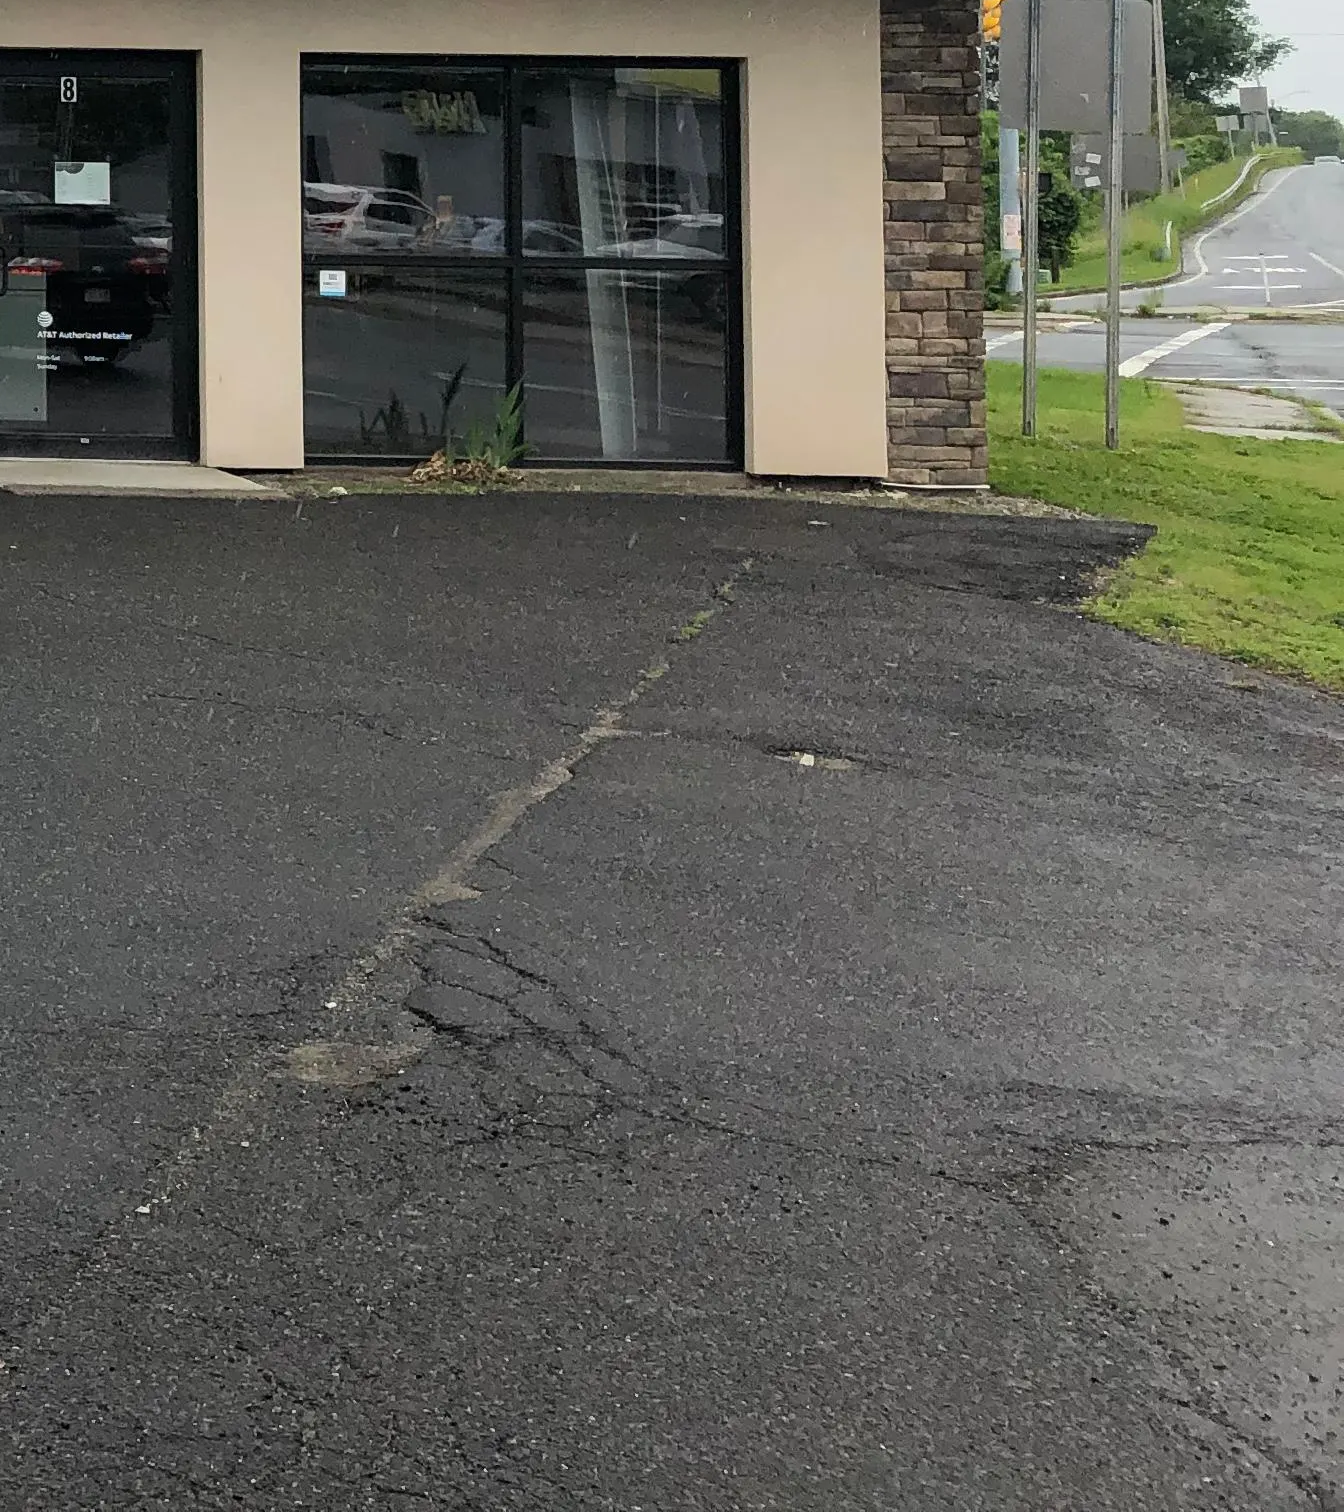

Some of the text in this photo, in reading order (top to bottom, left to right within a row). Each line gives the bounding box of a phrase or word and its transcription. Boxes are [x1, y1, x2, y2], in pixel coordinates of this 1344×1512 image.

[63, 78, 74, 101] 8
[37, 331, 57, 339] AT&T
[59, 331, 101, 340] Authorized
